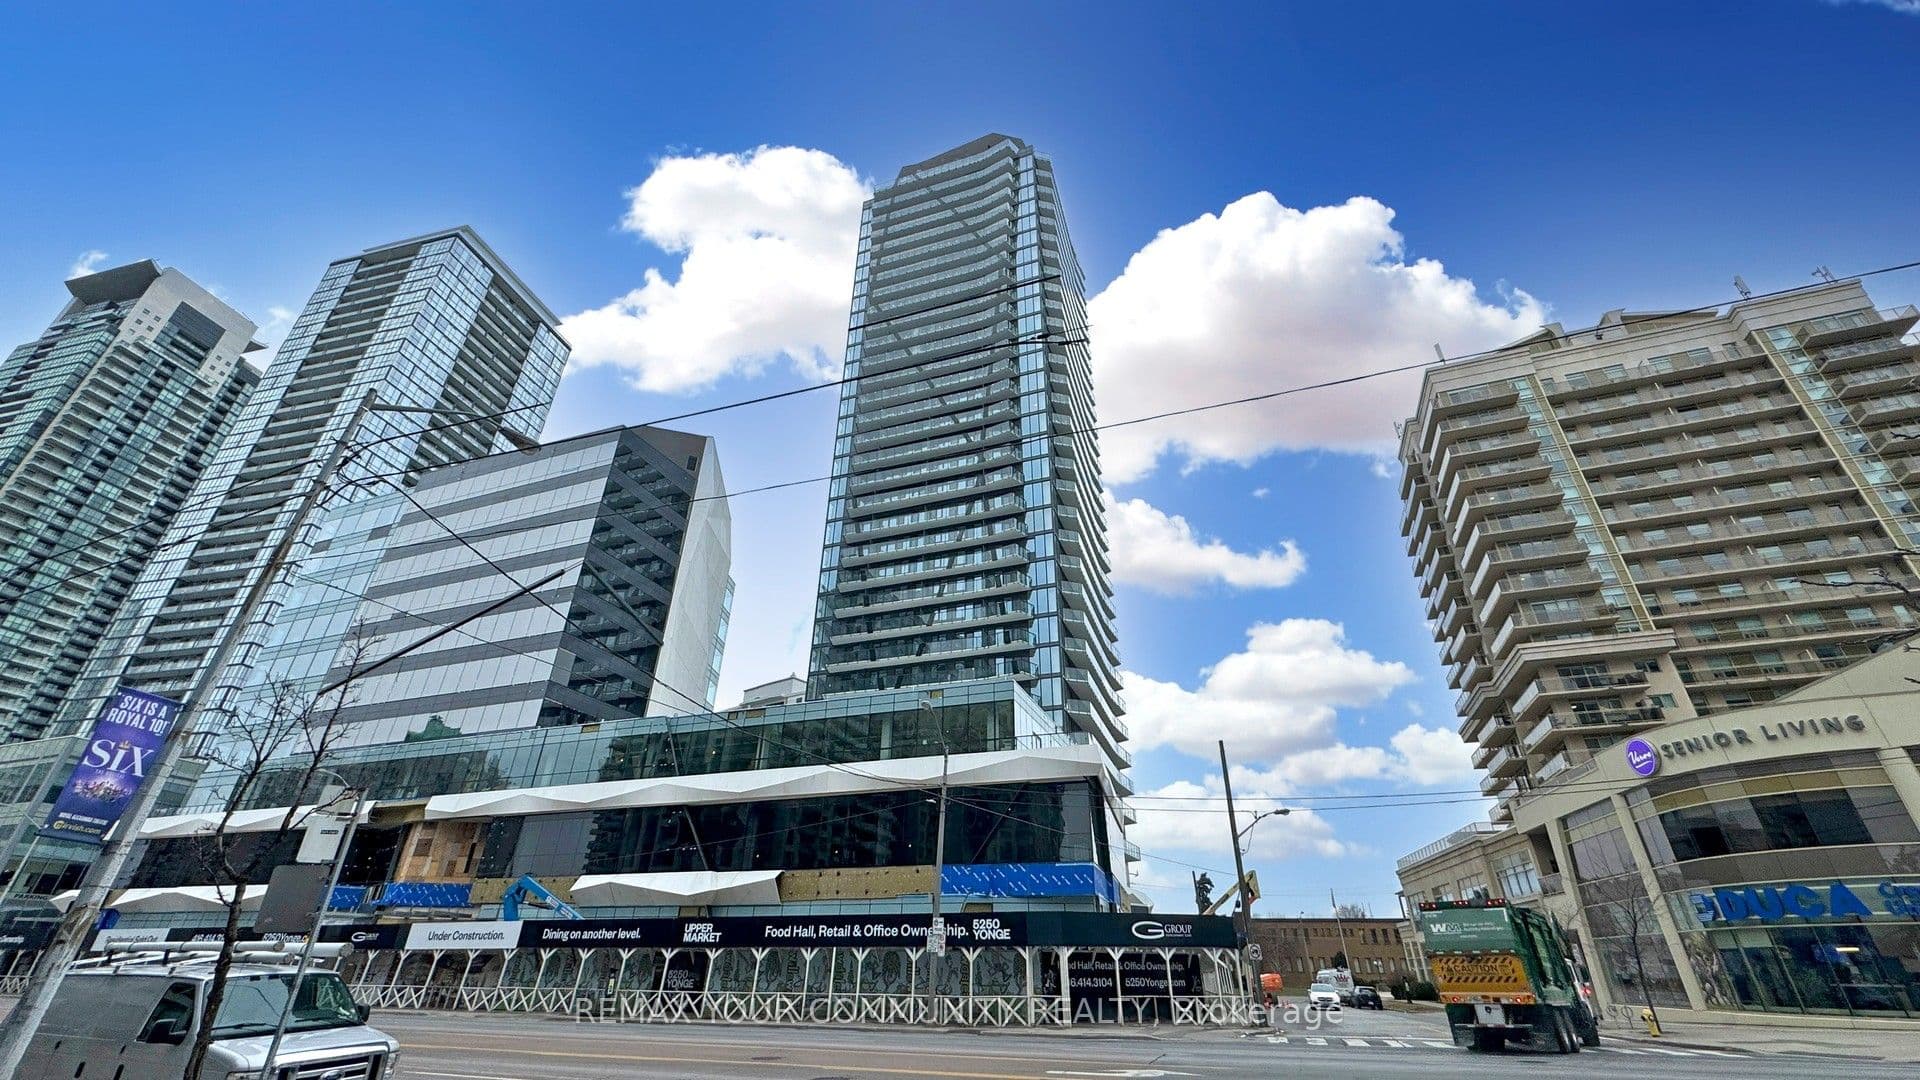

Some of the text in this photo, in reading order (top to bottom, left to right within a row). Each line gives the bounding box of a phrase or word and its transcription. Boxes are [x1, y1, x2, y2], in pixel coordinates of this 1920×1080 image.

[143, 700, 159, 716] IS
[157, 705, 168, 719] A
[106, 707, 147, 730] ROYAL
[1660, 714, 1866, 759] SENIOR LIVING
[684, 923, 714, 933] UPPER
[973, 919, 1000, 930] 5250
[1164, 924, 1192, 934] GROUP
[428, 929, 505, 941] Under Construction.
[542, 927, 641, 942] Dining on another level.
[765, 923, 969, 940] Food Hall, Retail & Office Ownehip.
[973, 929, 1011, 940] YONGE
[683, 932, 722, 943] MARKET
[1124, 961, 1146, 971] Office
[1453, 964, 1498, 975] CAUTION
[667, 978, 695, 989] YONGE
